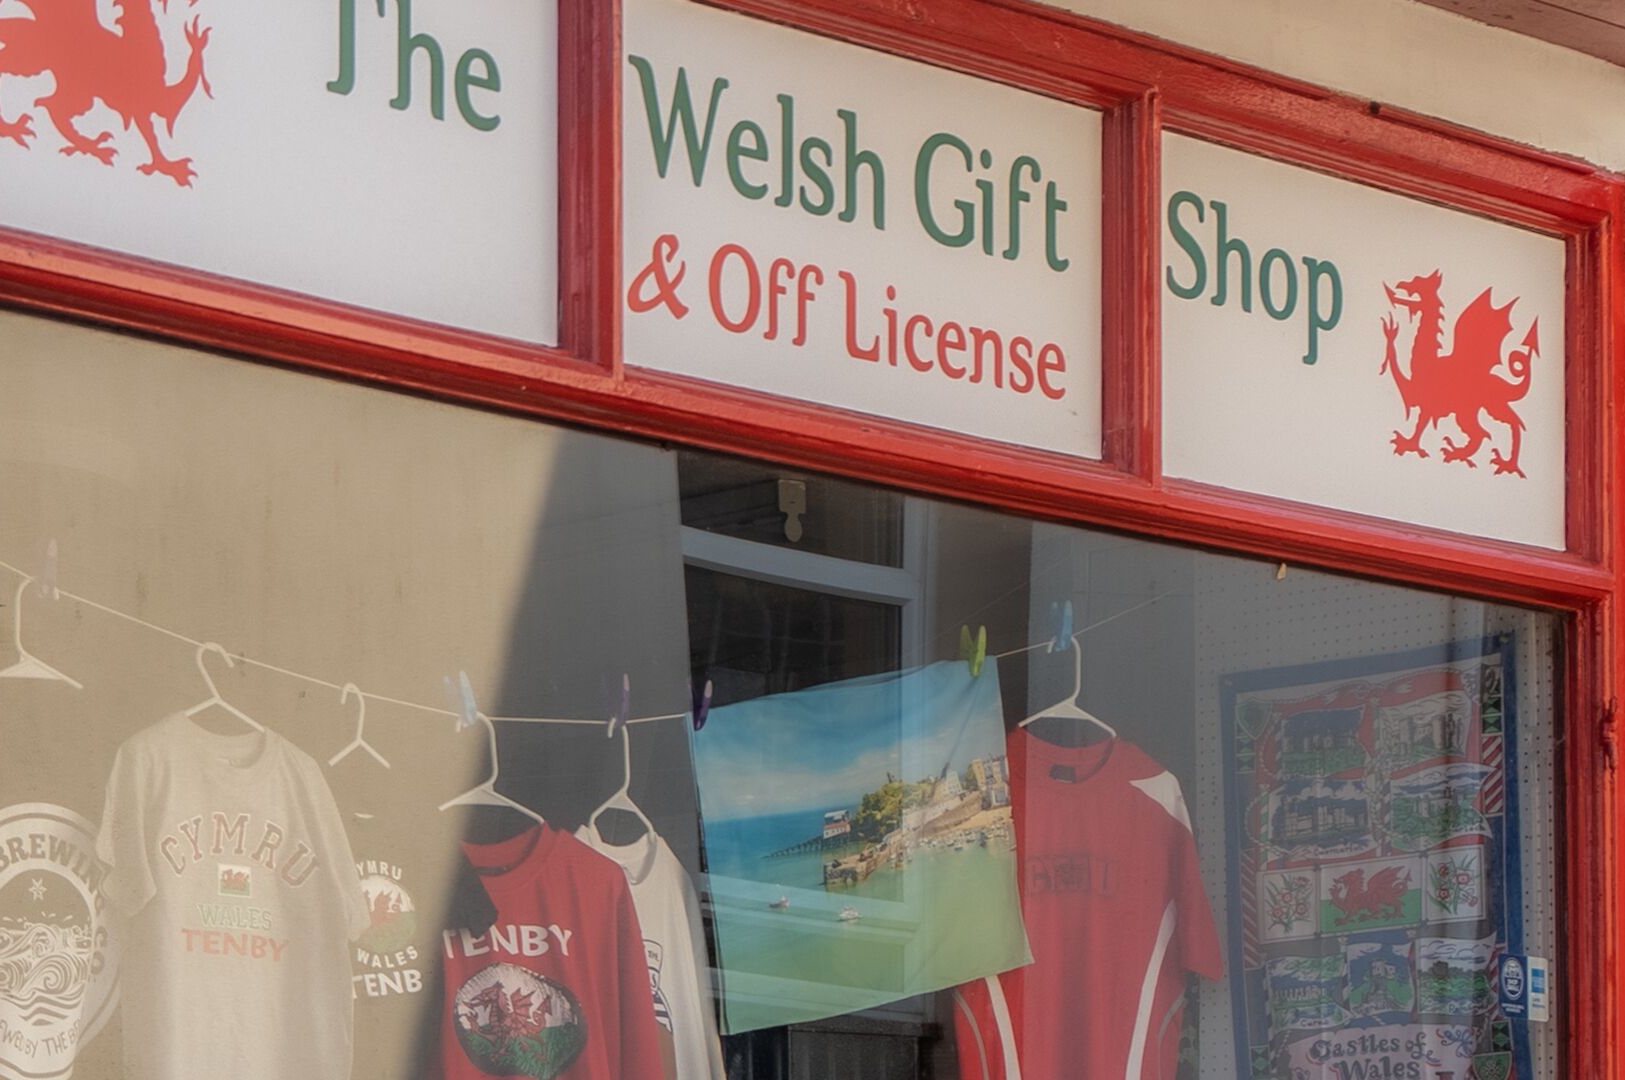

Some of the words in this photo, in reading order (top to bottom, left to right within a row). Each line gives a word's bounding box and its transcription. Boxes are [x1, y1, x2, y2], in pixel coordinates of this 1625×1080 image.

[326, 0, 501, 132] The
[628, 54, 887, 230] Welsh
[914, 132, 1070, 273] Gift
[1166, 190, 1344, 365] Shop
[627, 234, 689, 320] &
[709, 243, 824, 347] Off
[840, 271, 1067, 401] License
[160, 811, 320, 888] CYMRU
[355, 860, 403, 880] YMRU
[195, 903, 274, 931] WALES
[181, 928, 292, 962] TENBY
[357, 945, 418, 968] WALES
[442, 924, 572, 959] TENBY
[352, 969, 423, 999] TENB
[42, 1031, 68, 1057] THE
[1310, 1034, 1400, 1061] Castles
[1406, 1032, 1432, 1061] of
